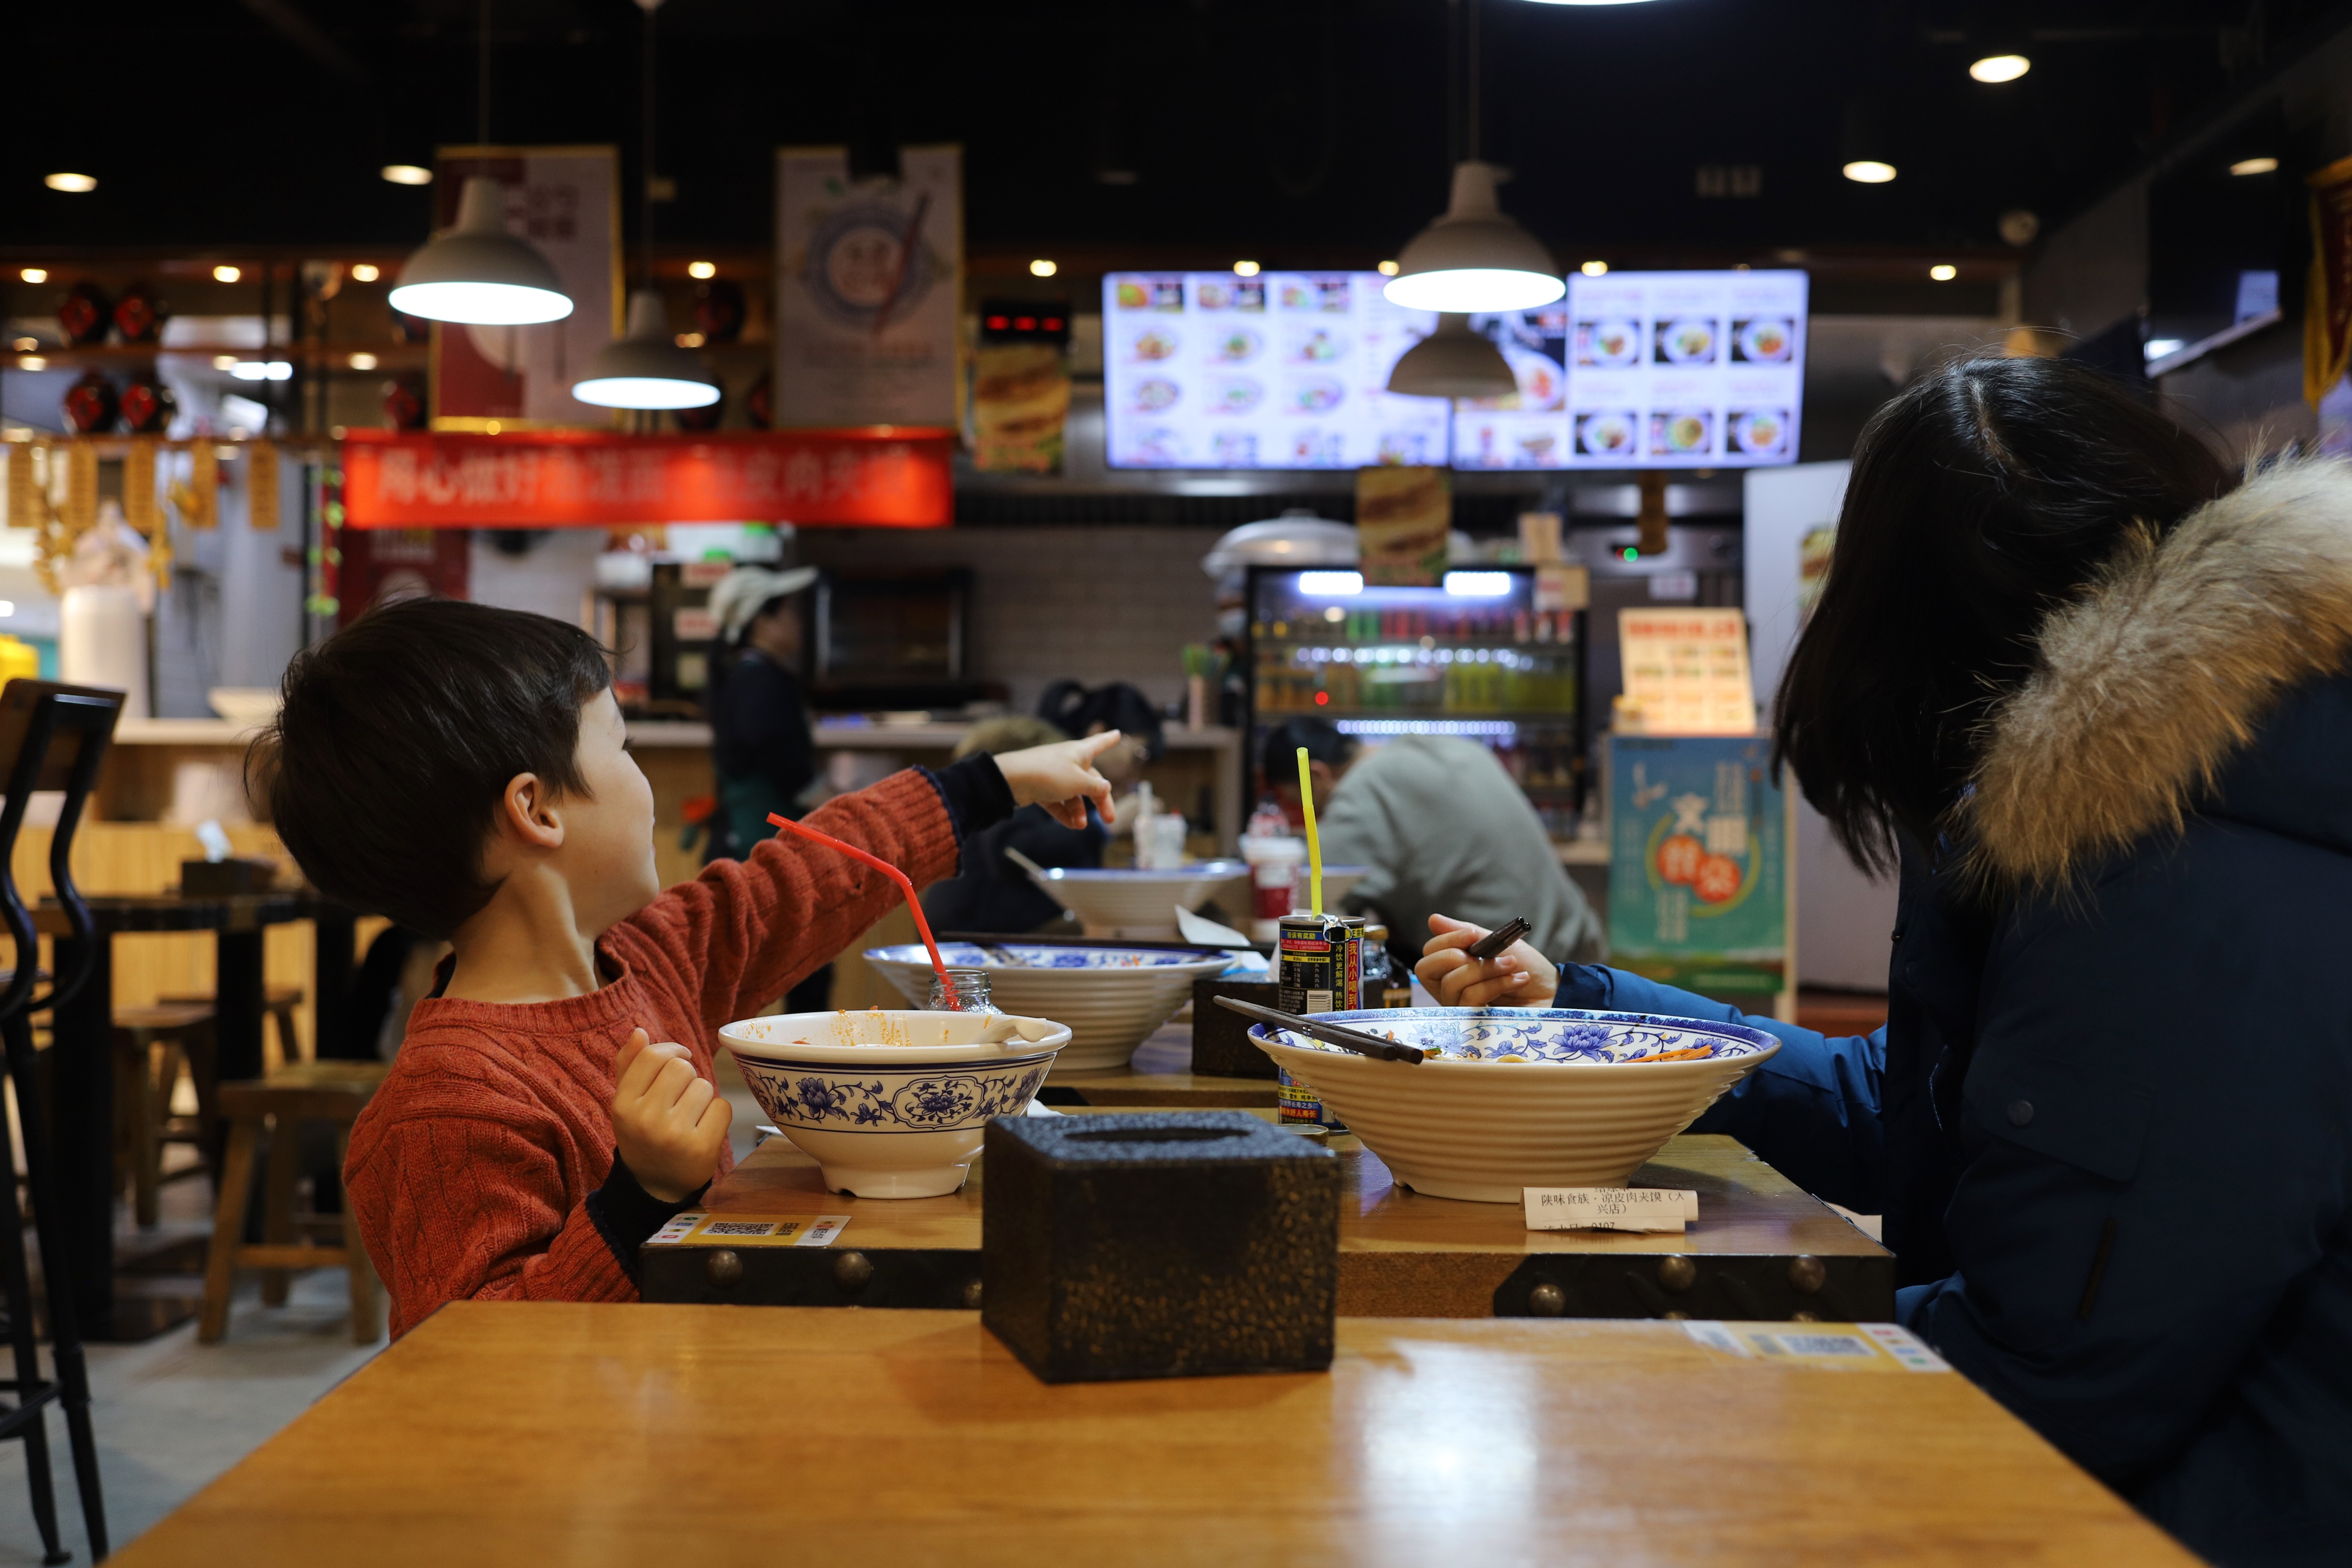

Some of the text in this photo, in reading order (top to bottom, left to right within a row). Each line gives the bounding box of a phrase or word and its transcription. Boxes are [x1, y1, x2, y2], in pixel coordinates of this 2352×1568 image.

[1349, 943, 1357, 1011] 我从小喝到
